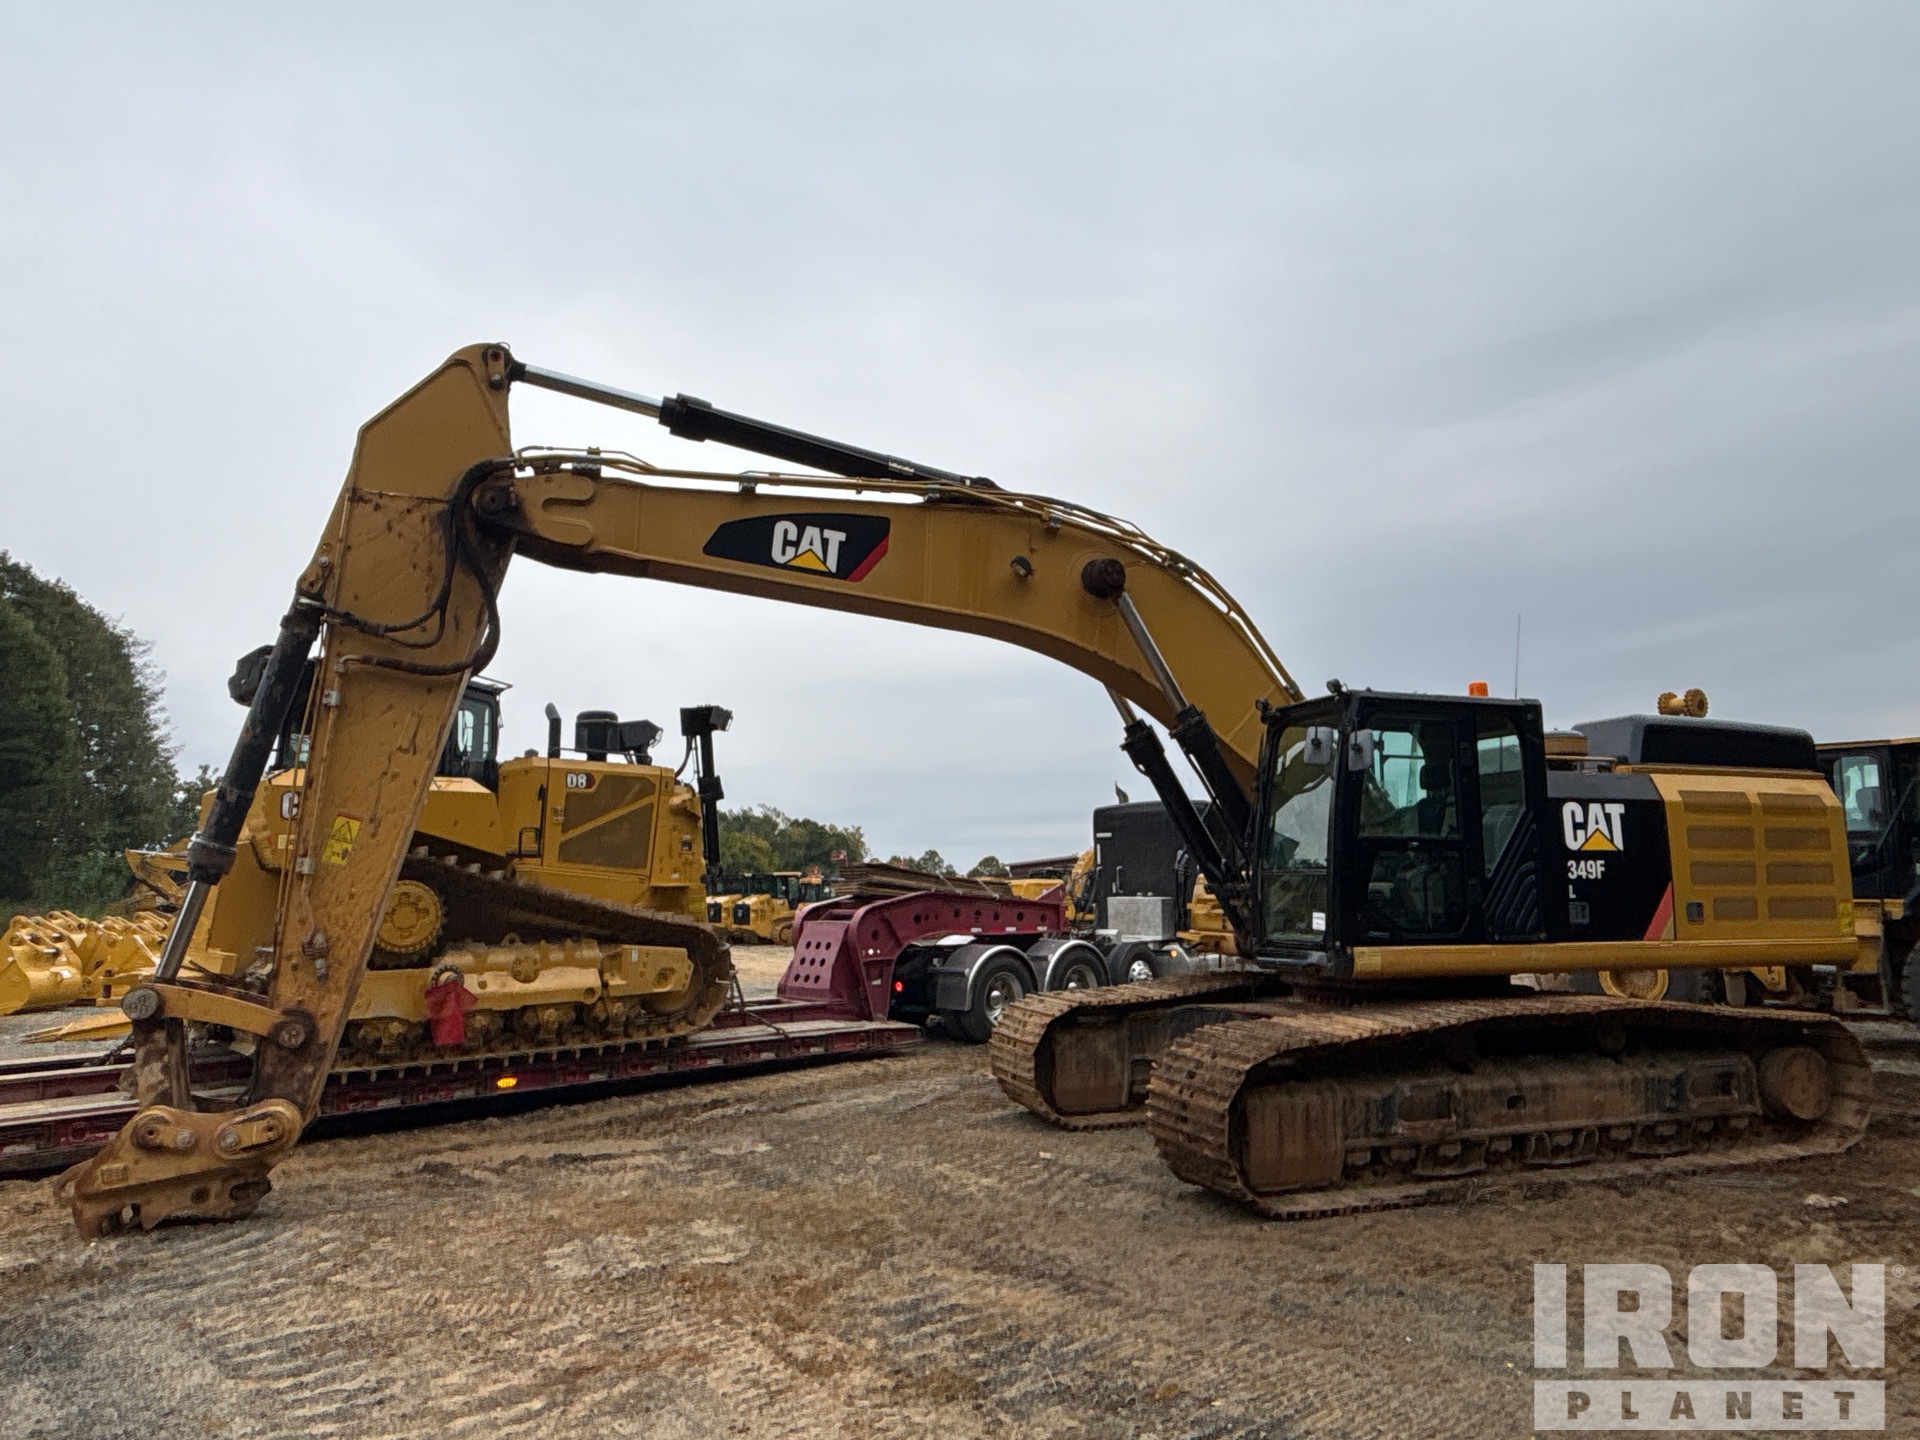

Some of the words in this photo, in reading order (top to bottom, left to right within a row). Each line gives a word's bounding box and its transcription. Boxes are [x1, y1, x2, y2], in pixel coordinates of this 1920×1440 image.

[771, 520, 847, 574] CAT
[567, 774, 587, 788] D8
[1562, 801, 1625, 851] CAT
[1567, 860, 1605, 879] 349F
[1568, 884, 1576, 898] L
